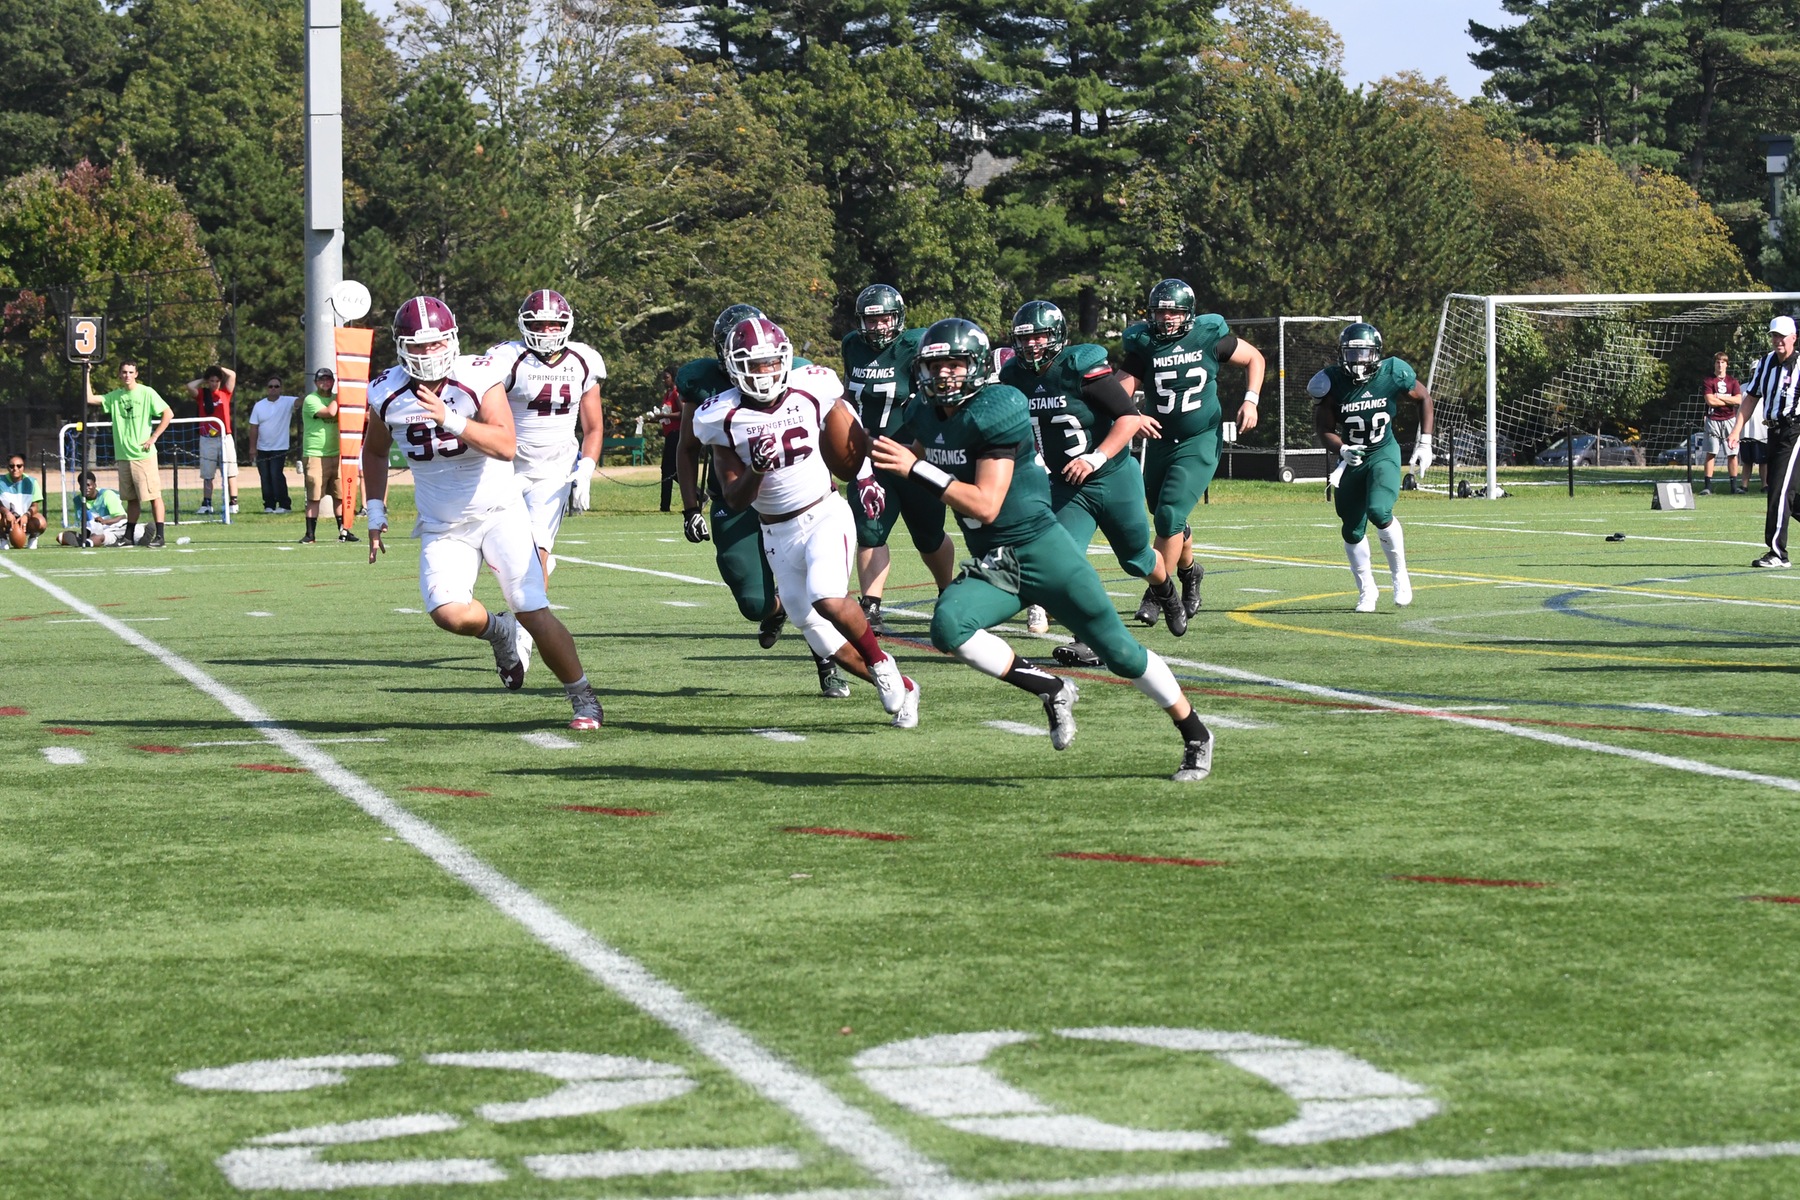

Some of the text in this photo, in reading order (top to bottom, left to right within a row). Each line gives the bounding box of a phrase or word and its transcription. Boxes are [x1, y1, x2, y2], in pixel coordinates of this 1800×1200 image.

[75, 321, 97, 354] 3
[1153, 349, 1203, 368] MUSTANGS
[527, 374, 576, 382] SPRINGFIELD
[851, 366, 895, 379] MUSTANGS
[526, 383, 572, 417] 41
[1154, 366, 1208, 414] 52
[848, 381, 897, 428] 77
[1340, 397, 1388, 413] MUSTANGS
[746, 415, 804, 435] SPRINGFIELD
[1666, 482, 1687, 509] G
